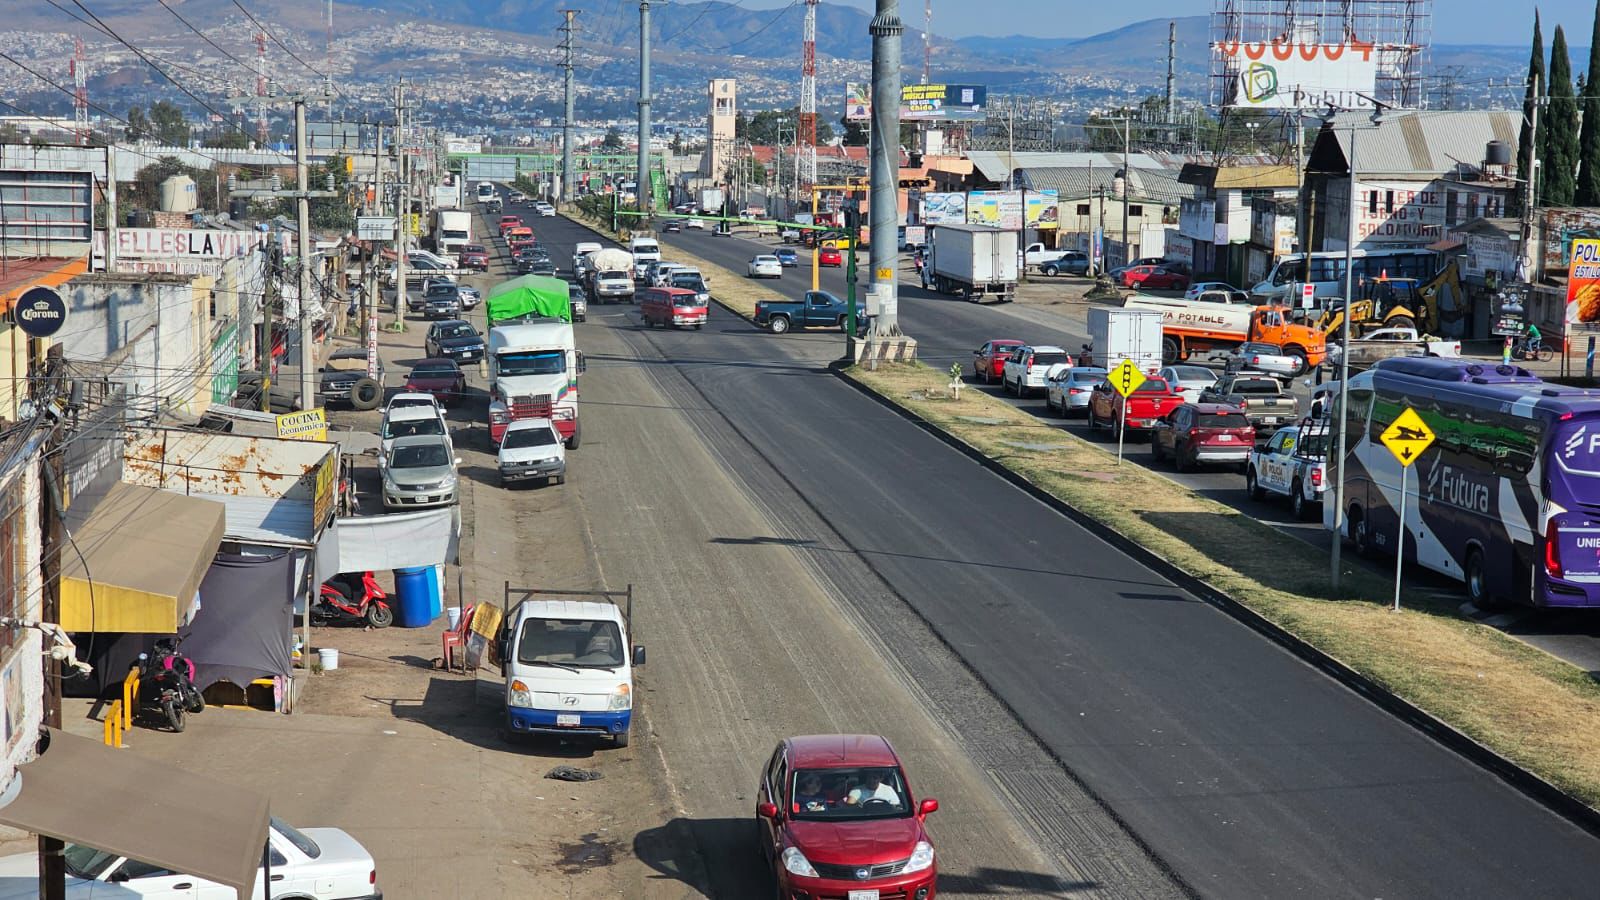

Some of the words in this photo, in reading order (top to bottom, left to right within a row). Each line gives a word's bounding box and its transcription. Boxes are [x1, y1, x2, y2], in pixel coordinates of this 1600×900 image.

[1420, 191, 1438, 204] DE
[1417, 207, 1425, 219] Y
[21, 308, 60, 321] Corona
[1178, 313, 1225, 324] POTABLE
[281, 411, 321, 427] COCINA
[1441, 466, 1489, 513] Futura
